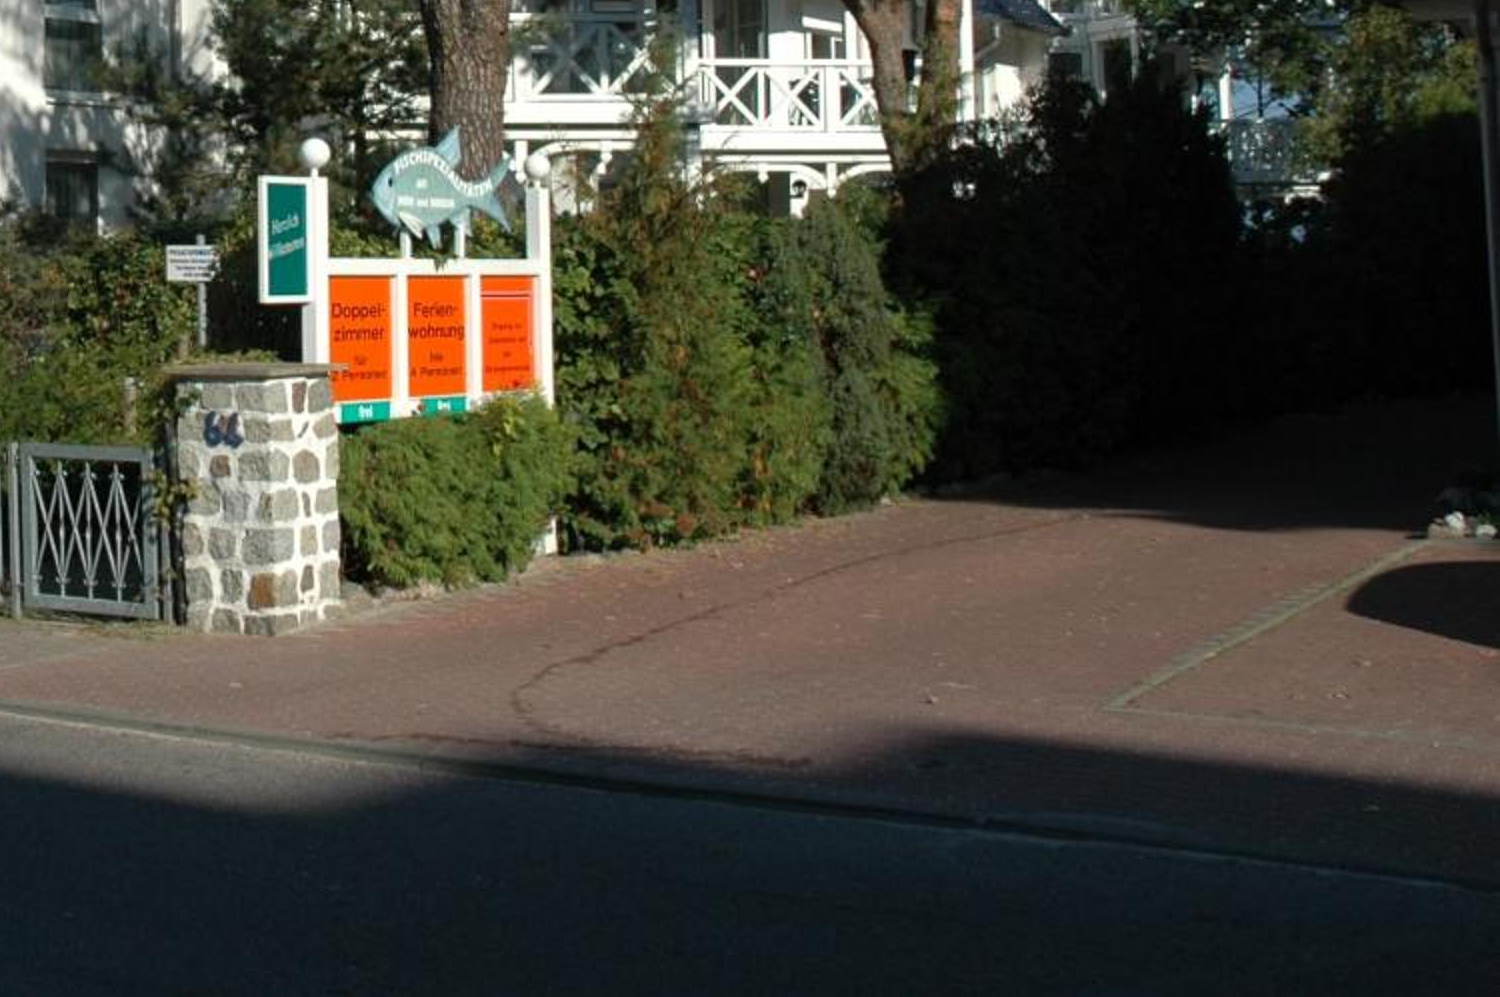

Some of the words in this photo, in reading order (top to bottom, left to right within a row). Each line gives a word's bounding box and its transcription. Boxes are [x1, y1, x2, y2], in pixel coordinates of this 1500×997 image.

[331, 303, 386, 321] Doppel-
[412, 302, 459, 319] Ferien-
[333, 325, 385, 341] zimmer
[407, 324, 465, 341] wohnung
